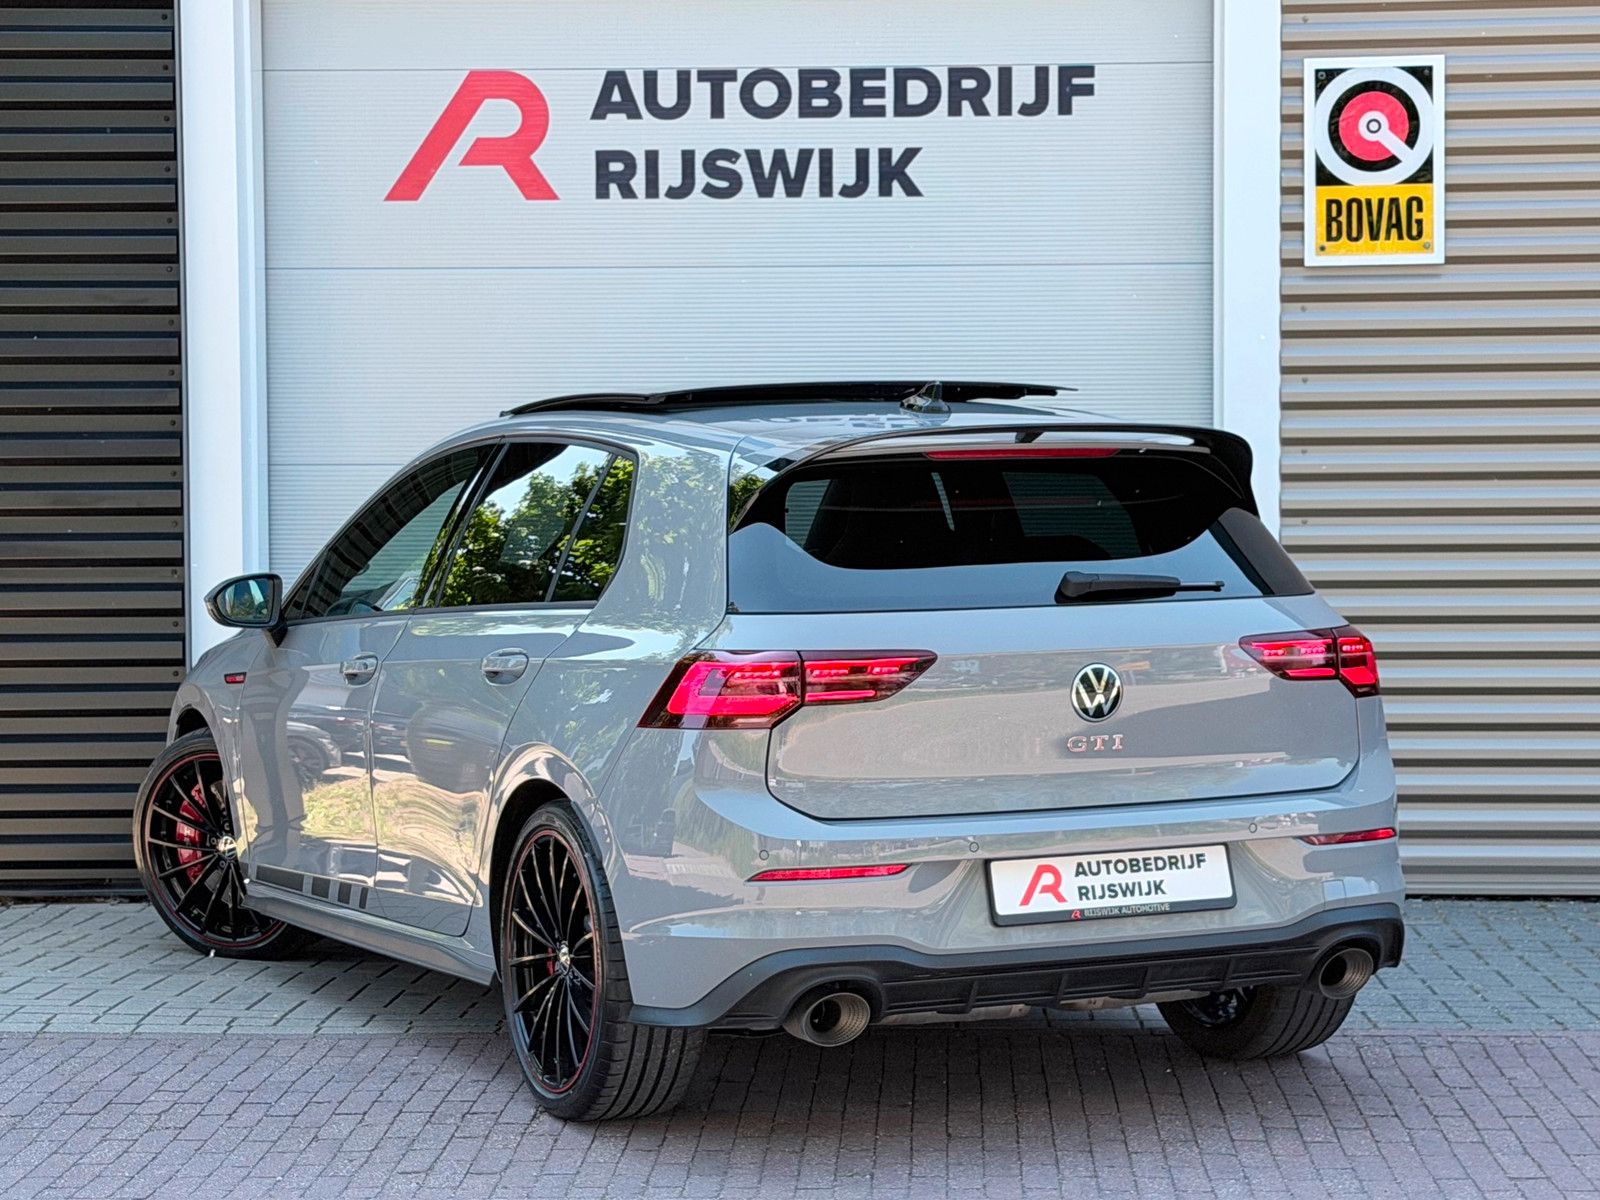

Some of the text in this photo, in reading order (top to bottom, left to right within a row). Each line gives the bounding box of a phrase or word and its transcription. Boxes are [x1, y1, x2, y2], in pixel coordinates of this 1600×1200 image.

[590, 65, 1096, 121] AUTOBEDRIJF
[595, 147, 924, 200] RIJSWIJK
[1325, 196, 1424, 243] BOVAG
[1067, 733, 1124, 753] GTI
[1074, 852, 1206, 878] AUTOBEDRIJF
[1077, 879, 1166, 902] RIJSWIJK
[1083, 902, 1171, 917] RIJSWIJK AUTOMOTIVE
